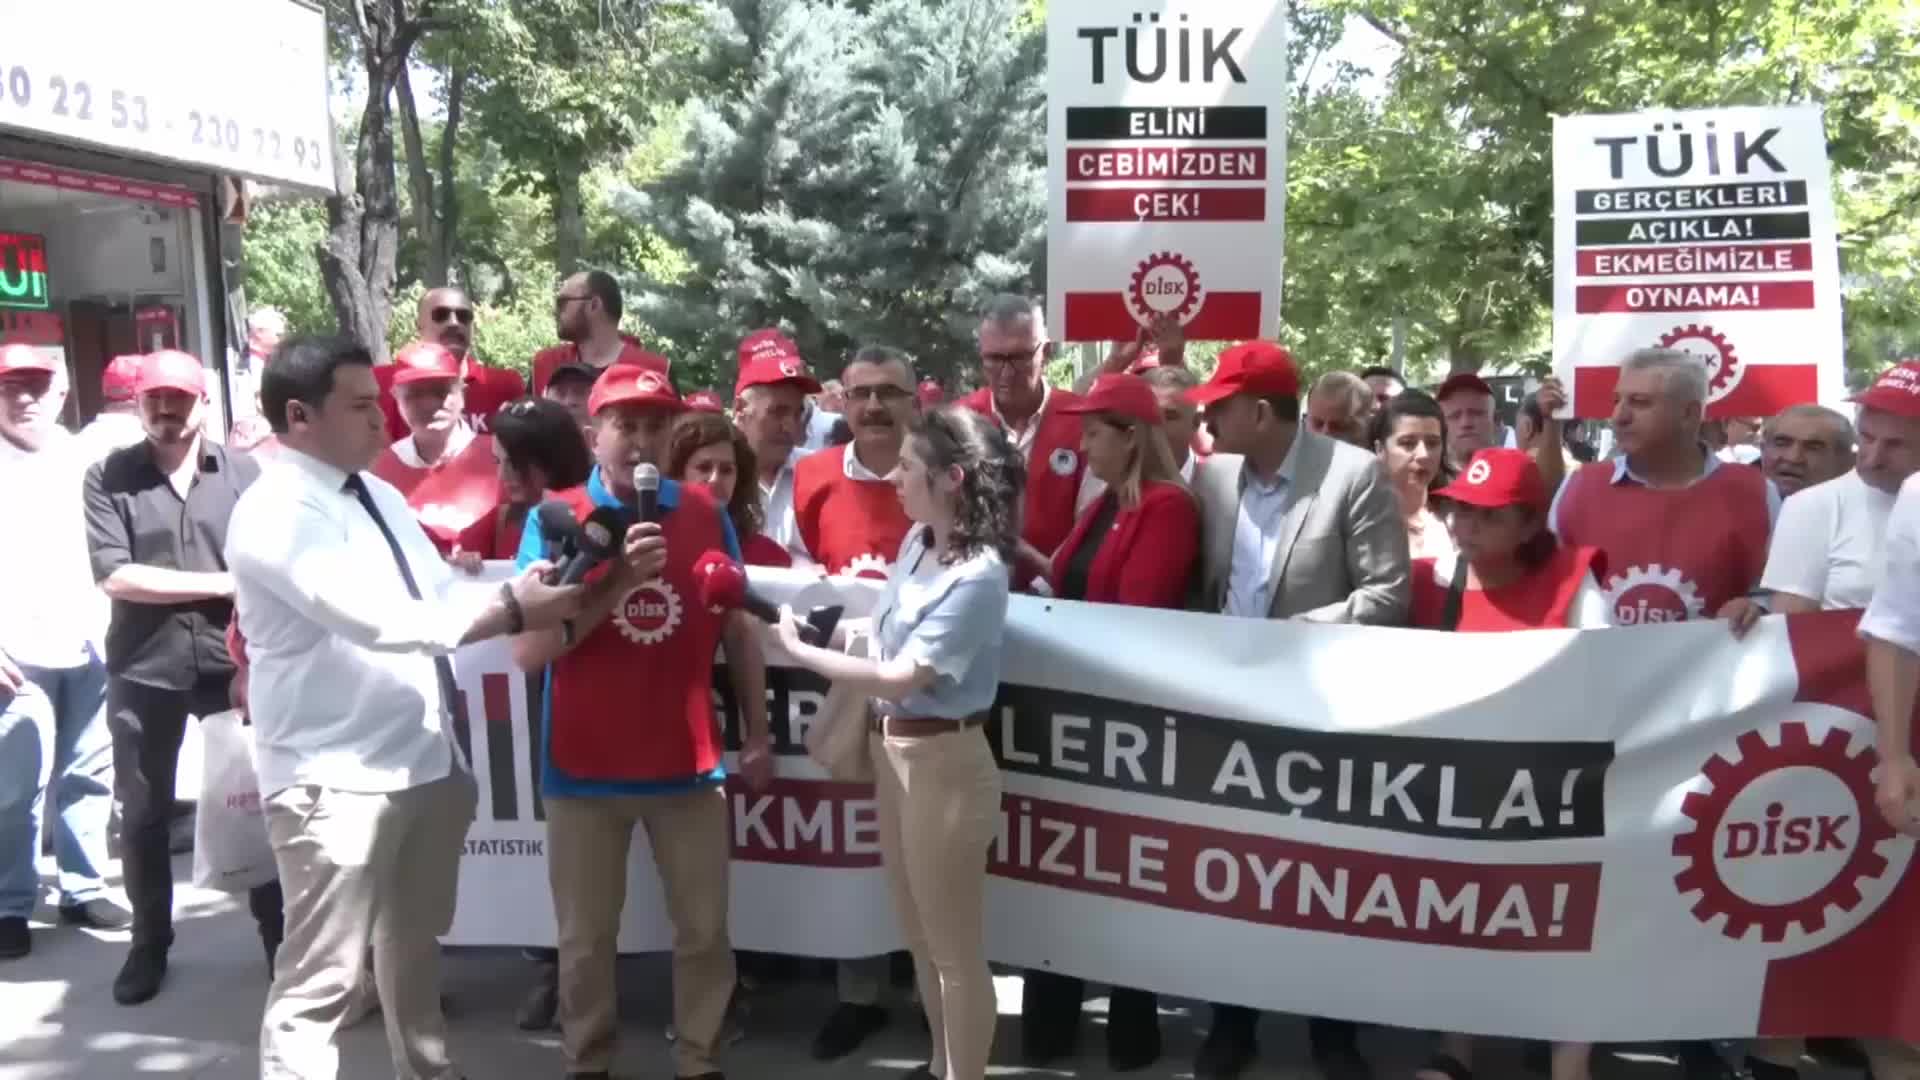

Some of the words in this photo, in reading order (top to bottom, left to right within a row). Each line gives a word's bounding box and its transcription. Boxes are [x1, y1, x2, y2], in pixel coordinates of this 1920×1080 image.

[1077, 12, 1248, 84] TÜİK
[49, 74, 94, 121] 22
[111, 87, 149, 133] 53
[188, 110, 241, 153] 230
[293, 136, 321, 172] 93
[1130, 106, 1205, 136] ELİNİ
[1078, 147, 1257, 177] CEBİMİZDEN
[1593, 121, 1788, 180] TÜİK
[1133, 193, 1200, 221] ÇEK!
[1593, 180, 1788, 212] GERÇEKLERİ
[1627, 218, 1753, 244] AÇIKLA!
[1594, 247, 1793, 274] EKMEĞİMİZLE
[1145, 276, 1186, 296] DİSK
[1625, 285, 1760, 307] OYNAMA!
[627, 597, 667, 617] DİSK
[1211, 739, 1584, 831] AÇIKLA!
[1724, 801, 1851, 859] DİSK
[1193, 848, 1570, 939] OYNAMA!
